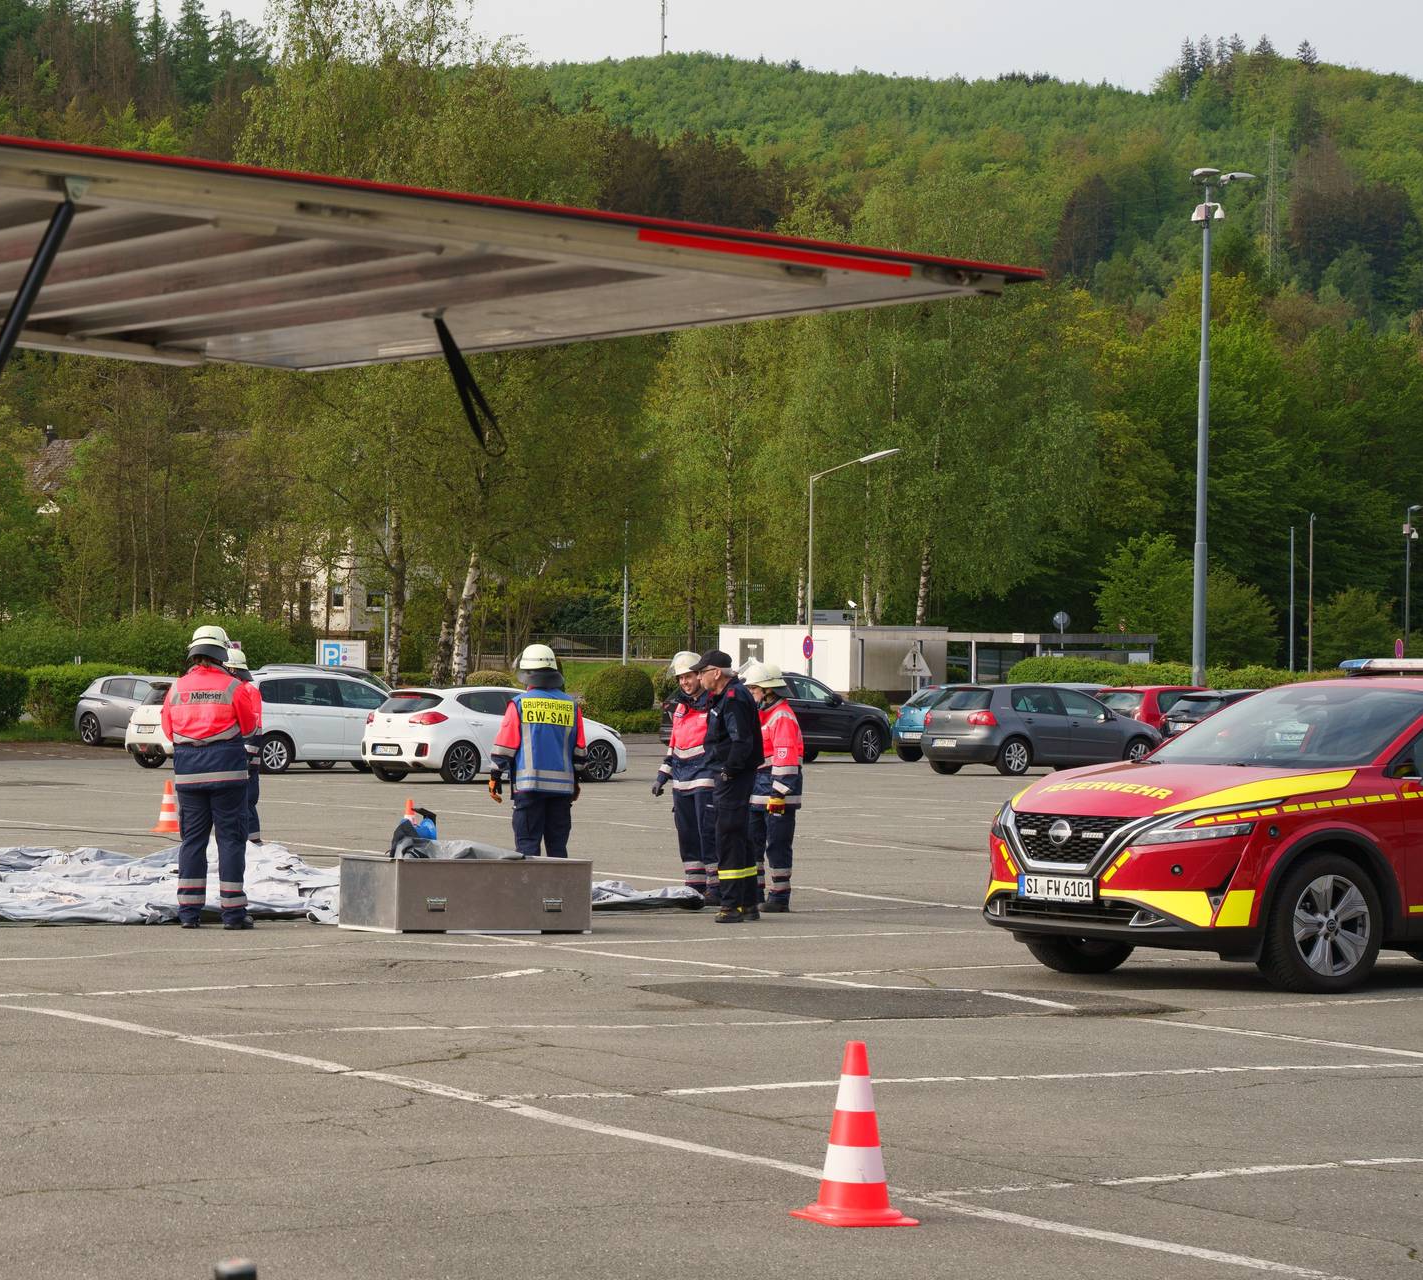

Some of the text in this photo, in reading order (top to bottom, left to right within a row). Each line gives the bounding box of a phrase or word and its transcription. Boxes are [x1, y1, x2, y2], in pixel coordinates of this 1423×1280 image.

[191, 691, 223, 700] Malteser
[527, 710, 570, 725] GW-SAN
[1037, 781, 1174, 800] FEUERWEHR
[1026, 878, 1091, 898] SI FW 6101
